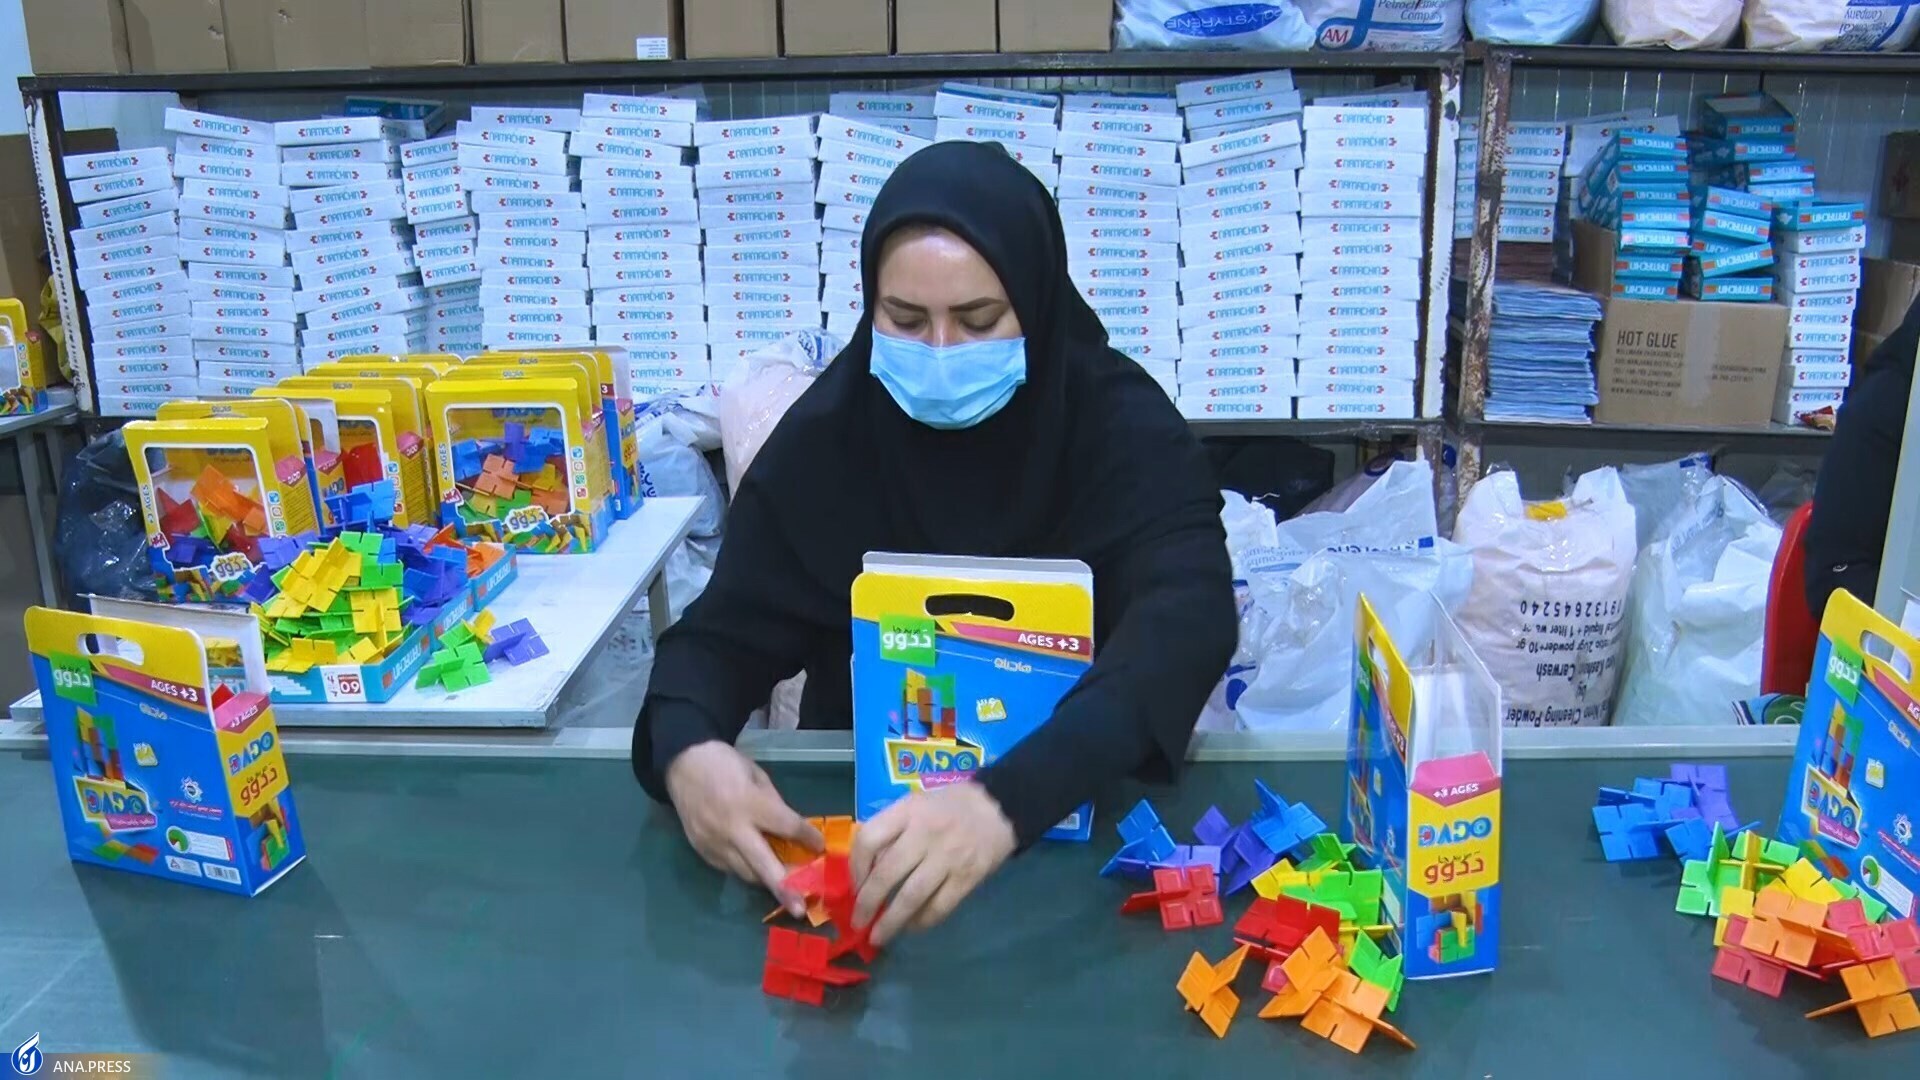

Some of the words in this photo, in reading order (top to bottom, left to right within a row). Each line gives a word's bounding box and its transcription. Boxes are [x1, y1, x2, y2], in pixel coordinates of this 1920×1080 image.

[1322, 28, 1348, 43] AM
[1716, 251, 1758, 268] NAMACHIN
[1718, 285, 1758, 295] NAMACHIN
[1617, 330, 1643, 346] HOT
[1646, 333, 1678, 348] GLUE
[439, 443, 449, 467] AGES
[1018, 634, 1053, 648] AGES
[1057, 636, 1080, 650] +3
[1536, 663, 1575, 682] Carwash
[151, 680, 178, 696] AGES
[180, 688, 198, 702] +3
[1506, 708, 1542, 728] Powder
[1544, 706, 1581, 725] Cleaning
[898, 750, 978, 774] DADO
[1450, 783, 1479, 796] AGES
[1418, 816, 1492, 847] DADO
